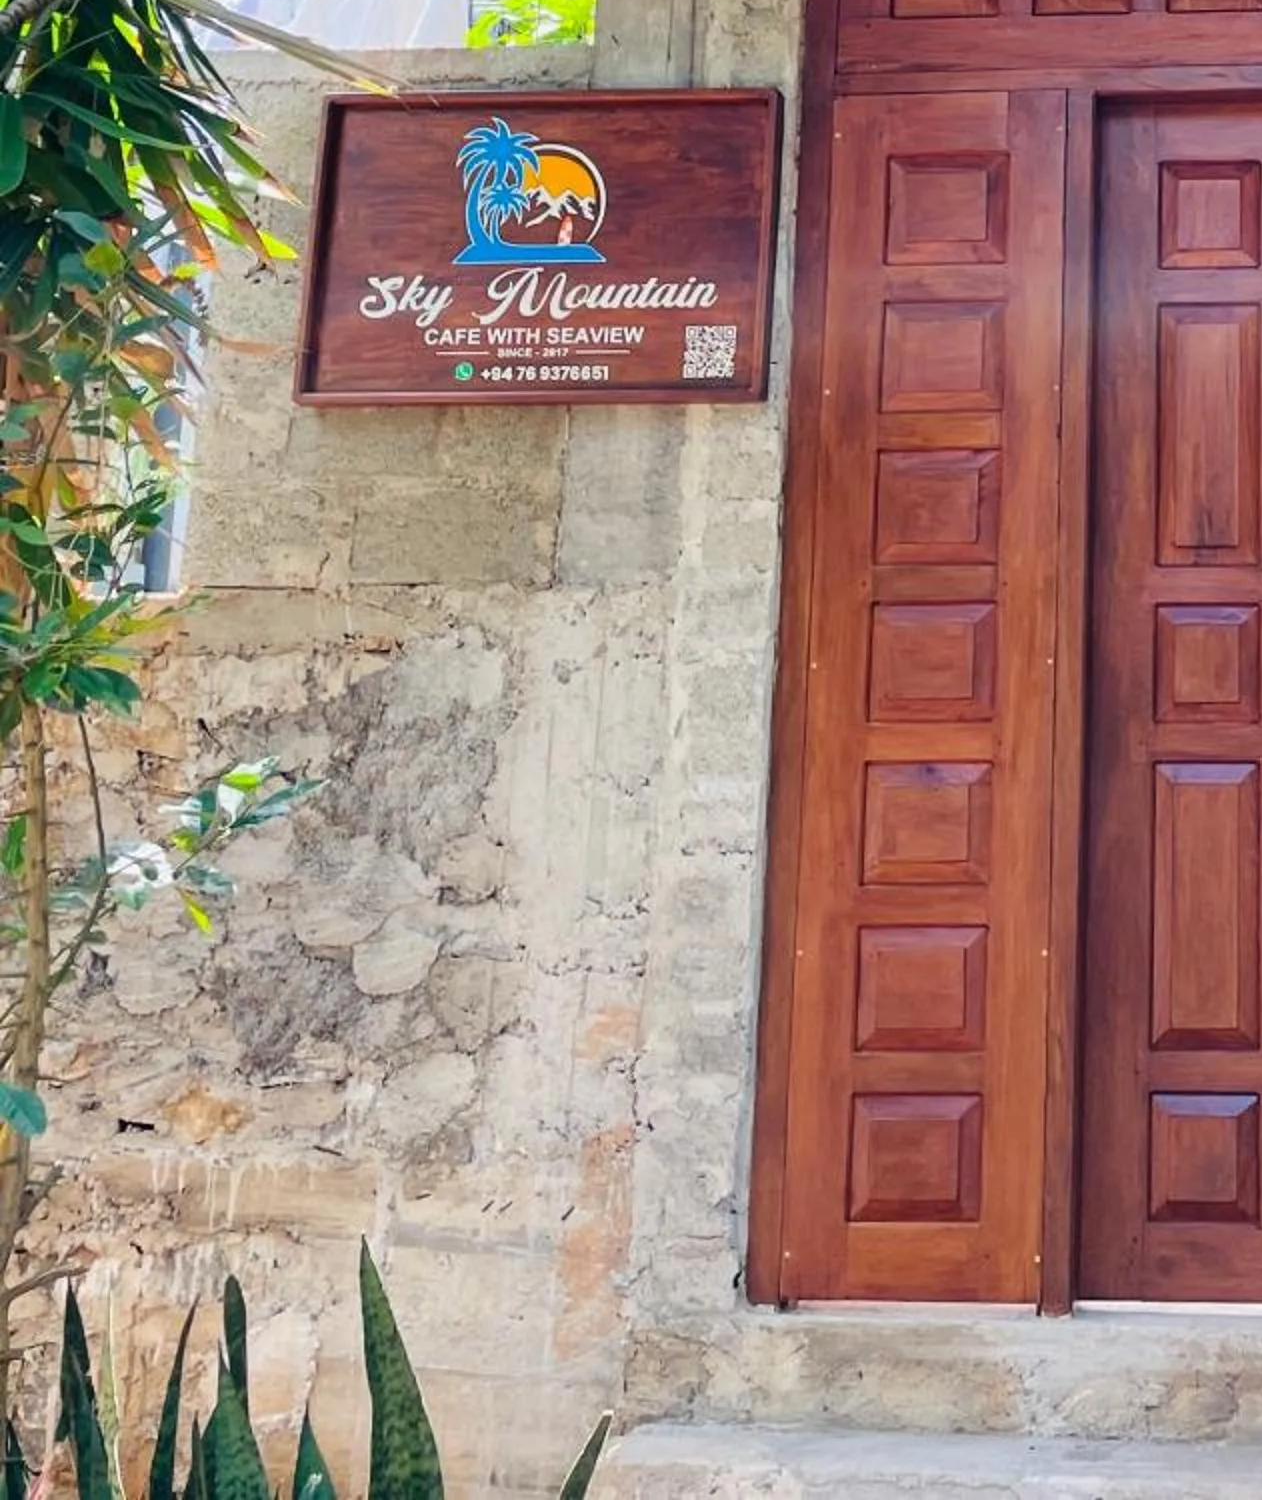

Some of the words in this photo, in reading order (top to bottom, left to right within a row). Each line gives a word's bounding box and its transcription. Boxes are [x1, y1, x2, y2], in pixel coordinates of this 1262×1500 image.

[359, 275, 452, 327] Sky
[472, 267, 718, 325] Mountain
[425, 327, 481, 345] CAFE
[488, 327, 540, 344] WITH
[545, 326, 645, 344] SEAVIEW
[497, 348, 533, 358] SINCE
[480, 368, 513, 381] +94
[516, 367, 536, 380] 76
[539, 366, 609, 380] 9376651
